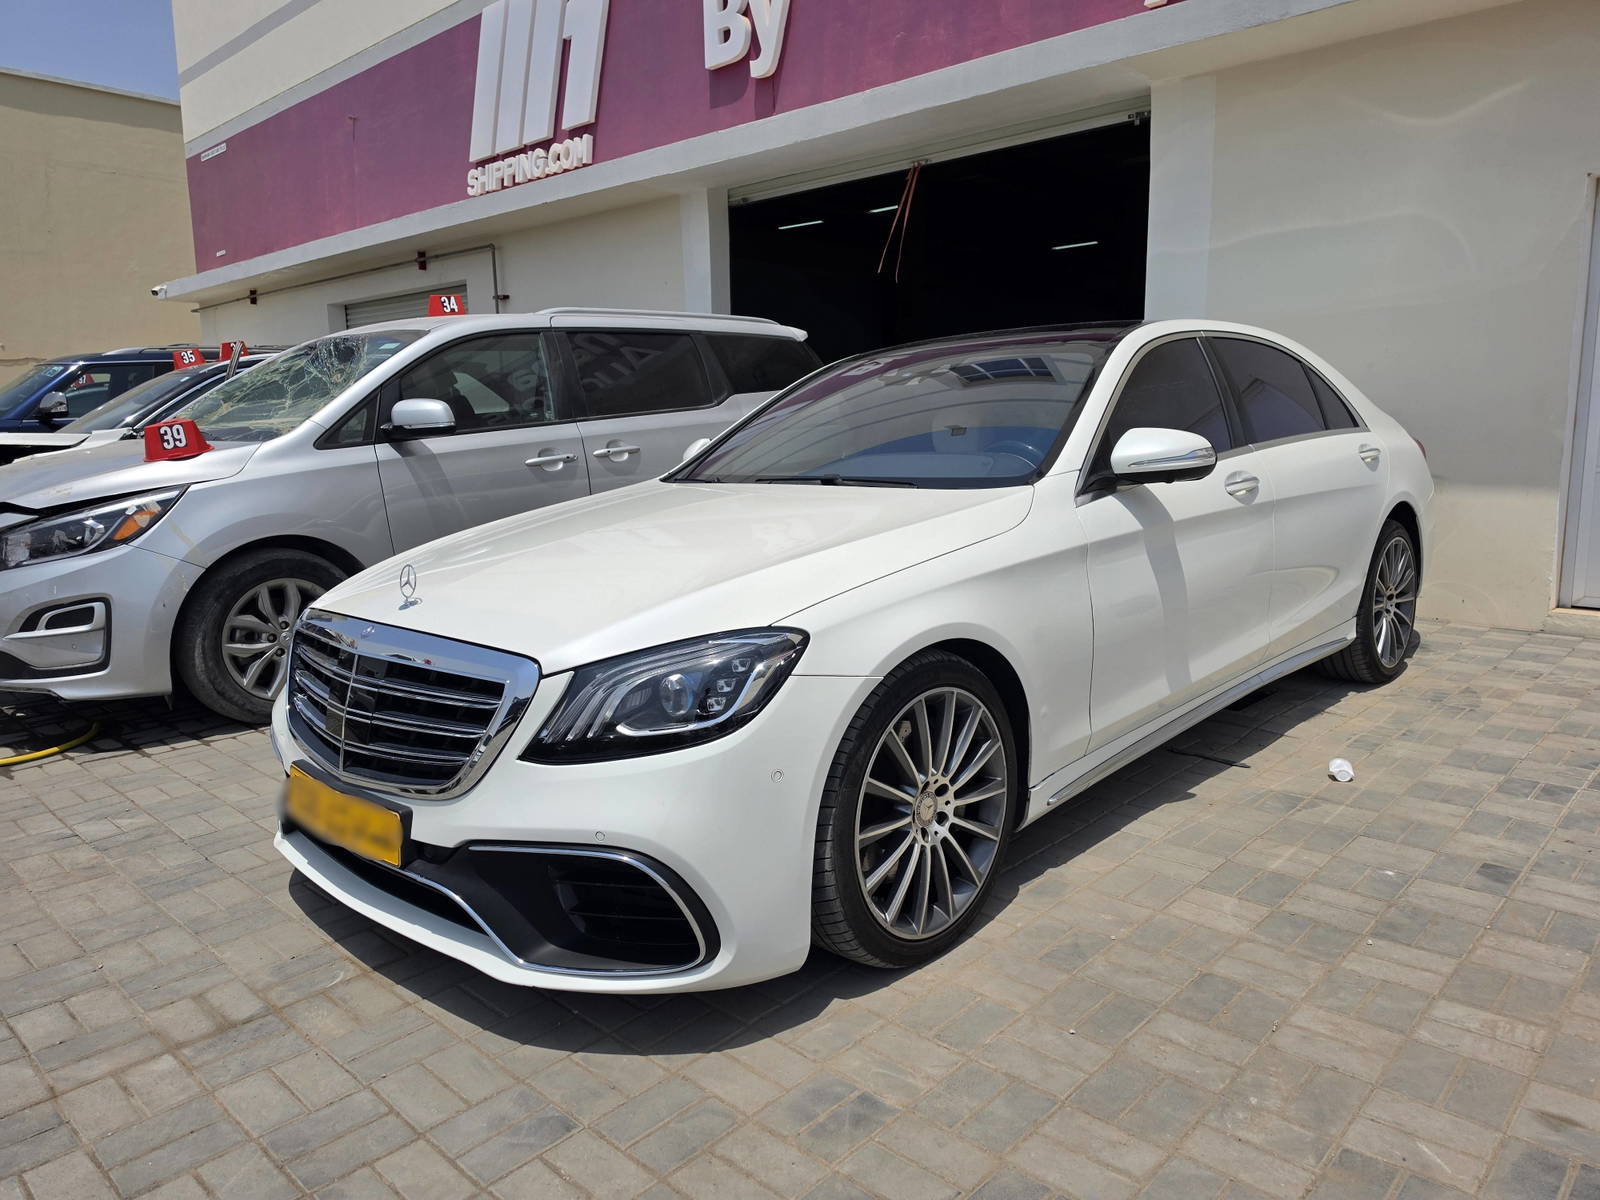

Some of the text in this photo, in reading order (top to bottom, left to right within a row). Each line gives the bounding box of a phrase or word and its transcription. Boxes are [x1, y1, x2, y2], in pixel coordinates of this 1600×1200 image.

[703, 0, 790, 79] By
[467, 133, 594, 197] SHIPPING.COM
[440, 296, 459, 313] 34
[180, 350, 196, 364] 35
[160, 424, 187, 450] 39
